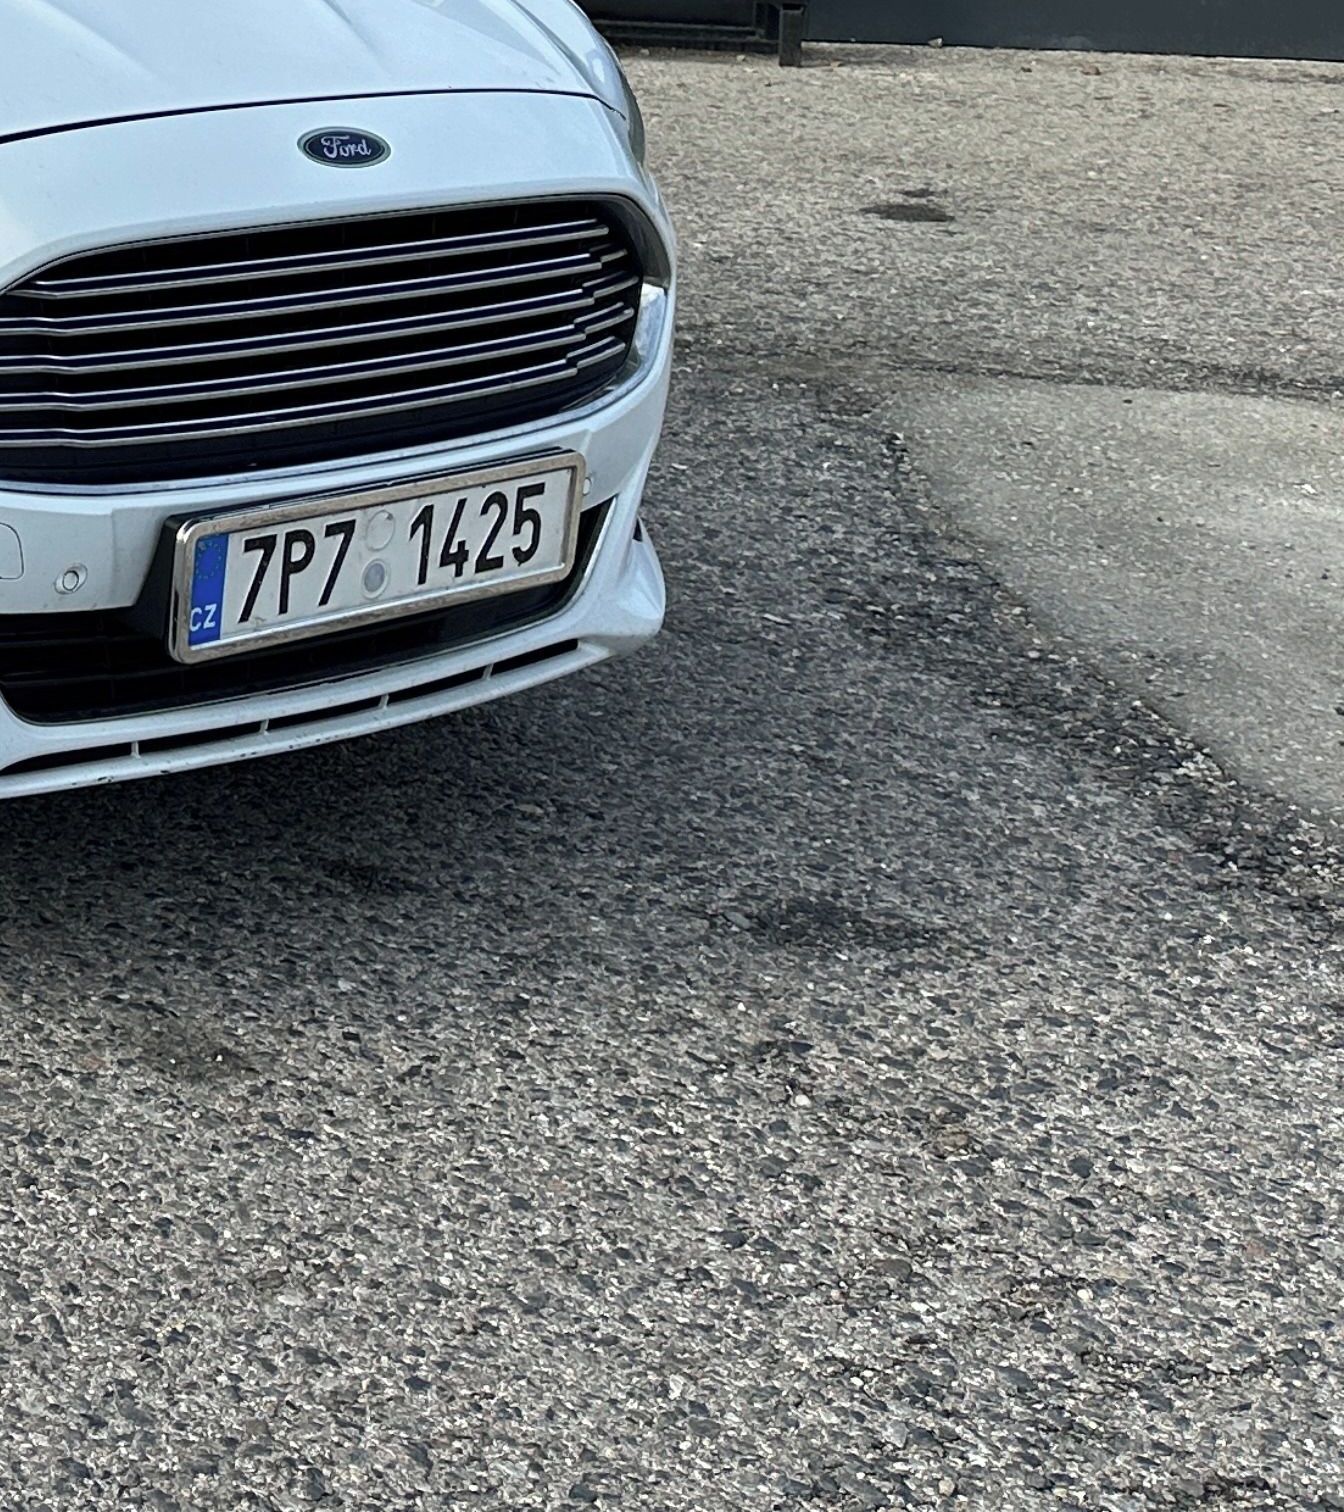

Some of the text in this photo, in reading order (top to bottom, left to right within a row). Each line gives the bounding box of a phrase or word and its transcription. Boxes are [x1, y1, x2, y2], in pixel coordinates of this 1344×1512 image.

[321, 135, 372, 159] Ford
[238, 482, 546, 624] 7P7 1425
[189, 603, 217, 631] CZ
